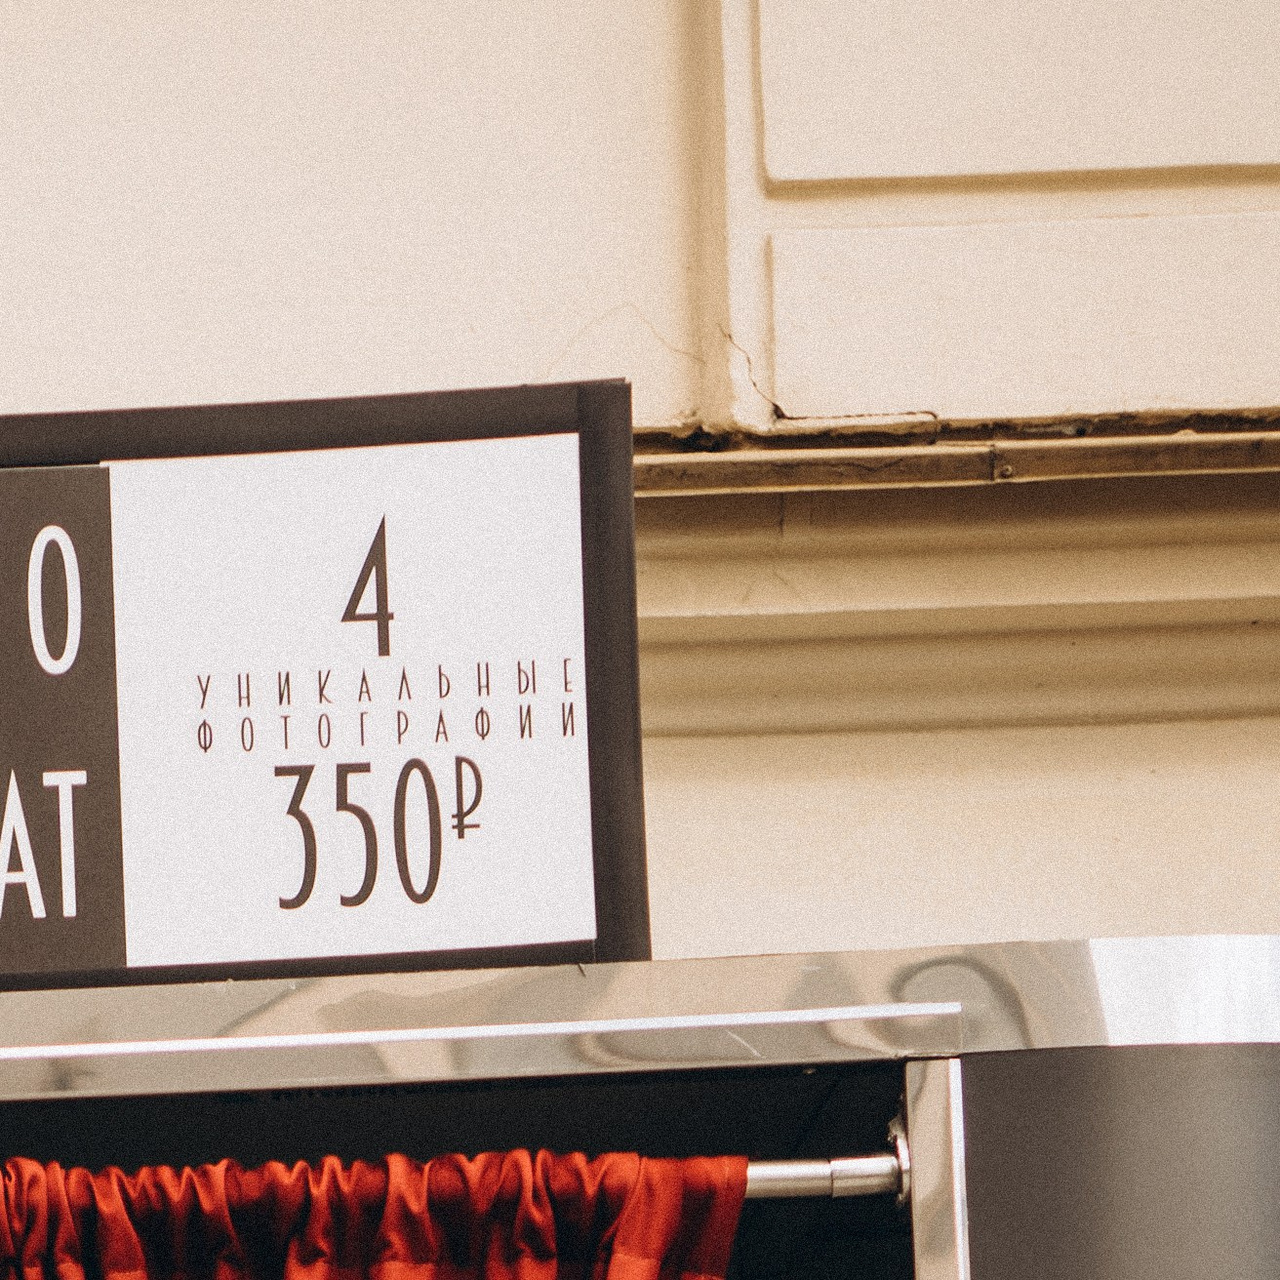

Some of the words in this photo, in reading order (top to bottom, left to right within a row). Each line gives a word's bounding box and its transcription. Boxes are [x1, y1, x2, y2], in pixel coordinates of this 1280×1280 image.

[341, 514, 395, 657] 4
[196, 657, 576, 710] УНИКАЛЬНЫЕ
[196, 702, 577, 753] ФОТОГРАФИИ
